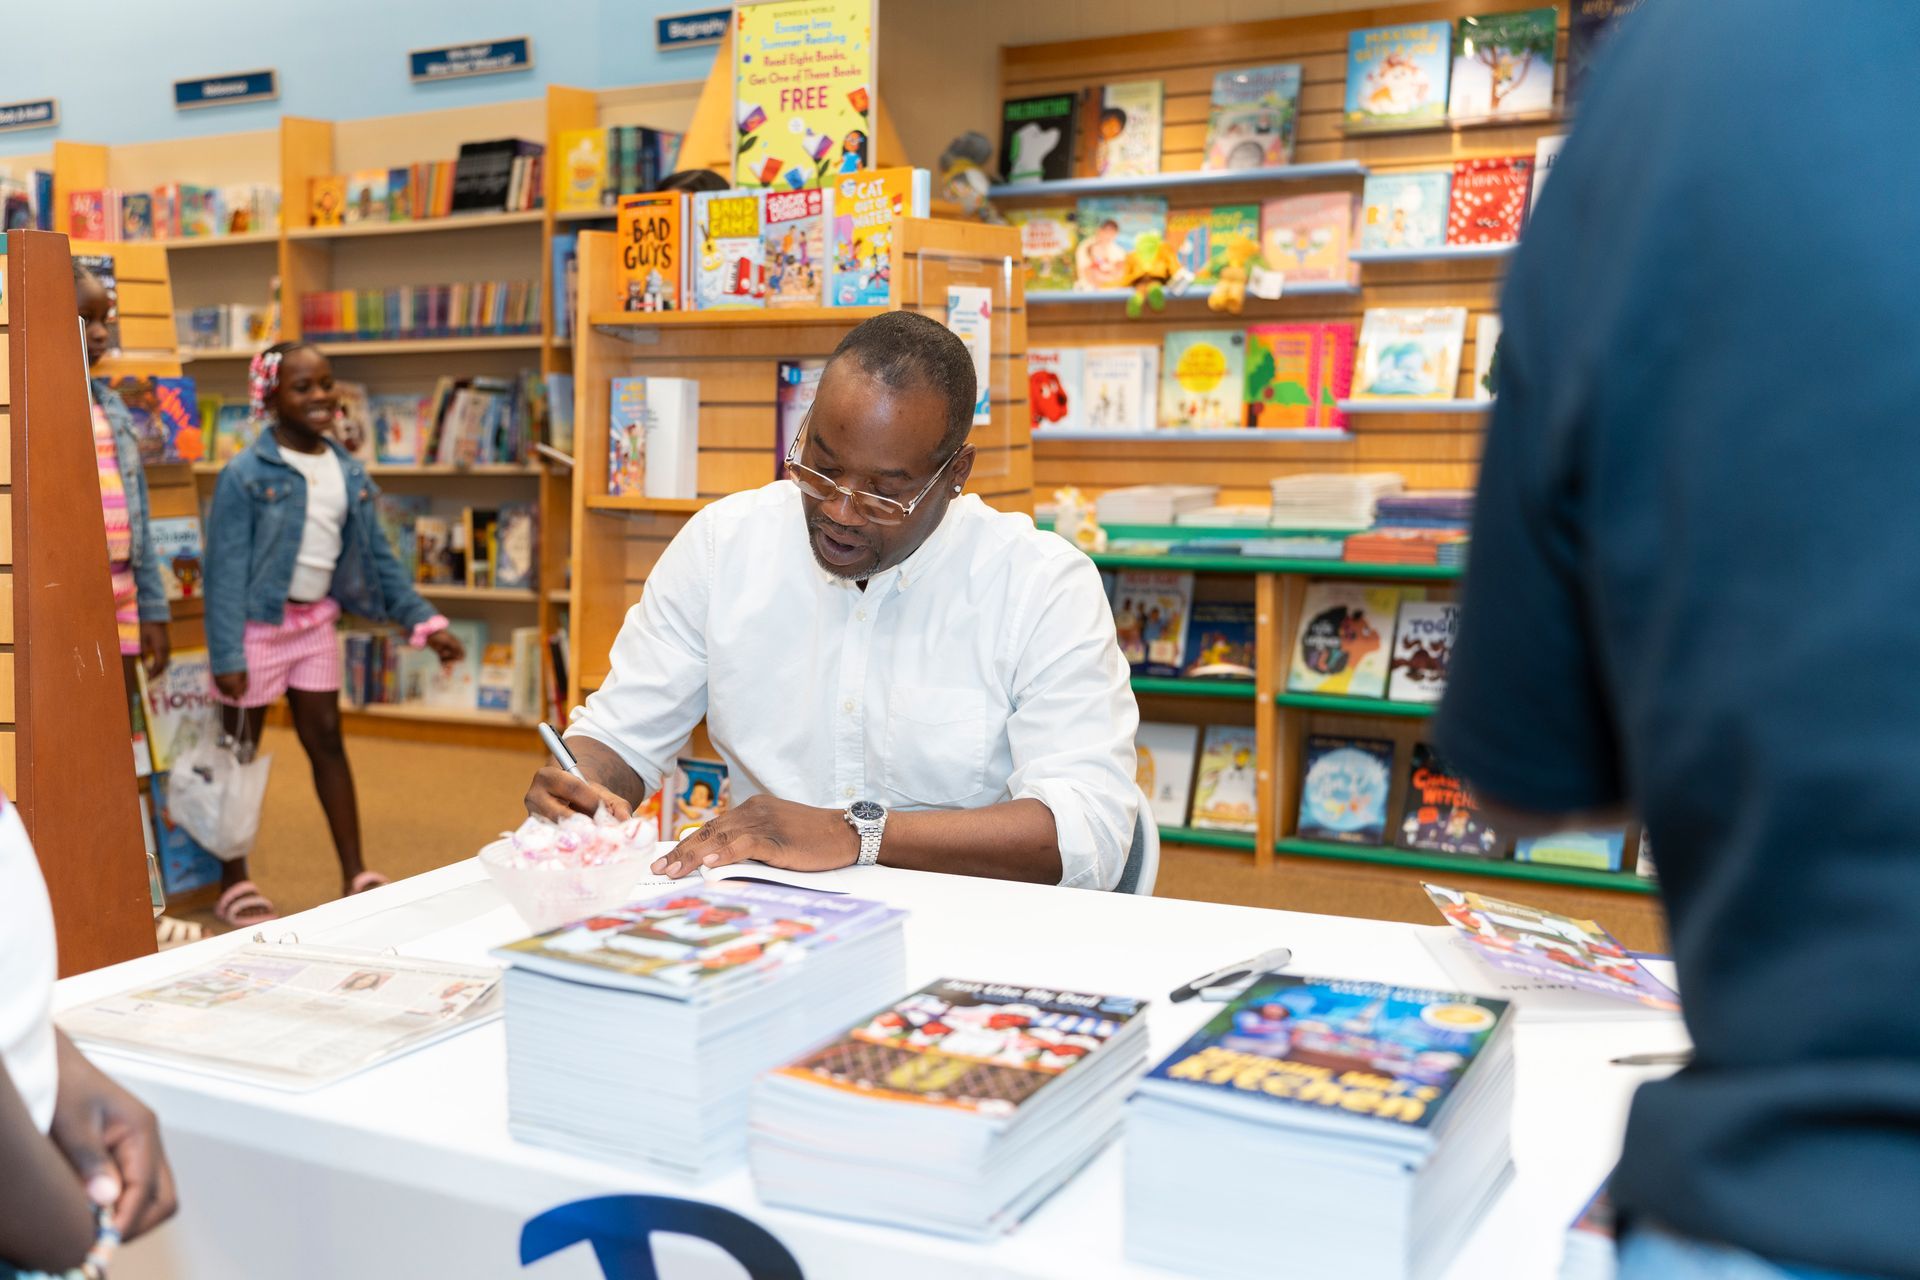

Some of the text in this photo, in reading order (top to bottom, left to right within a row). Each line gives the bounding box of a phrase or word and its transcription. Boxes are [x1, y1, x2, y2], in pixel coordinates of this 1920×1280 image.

[774, 21, 809, 34] Escape
[761, 33, 846, 50] Summer Reading
[764, 55, 786, 66] Read
[789, 53, 814, 67] Eight
[749, 74, 766, 85] Get
[769, 72, 788, 83] One
[832, 66, 861, 77] Books
[780, 85, 829, 112] FREE
[857, 179, 885, 199] CAT
[709, 198, 757, 219] BAND
[633, 217, 670, 243] BAD
[710, 219, 757, 237] CAMP
[624, 244, 671, 270] GUYS
[1056, 990, 1100, 1007] Dad
